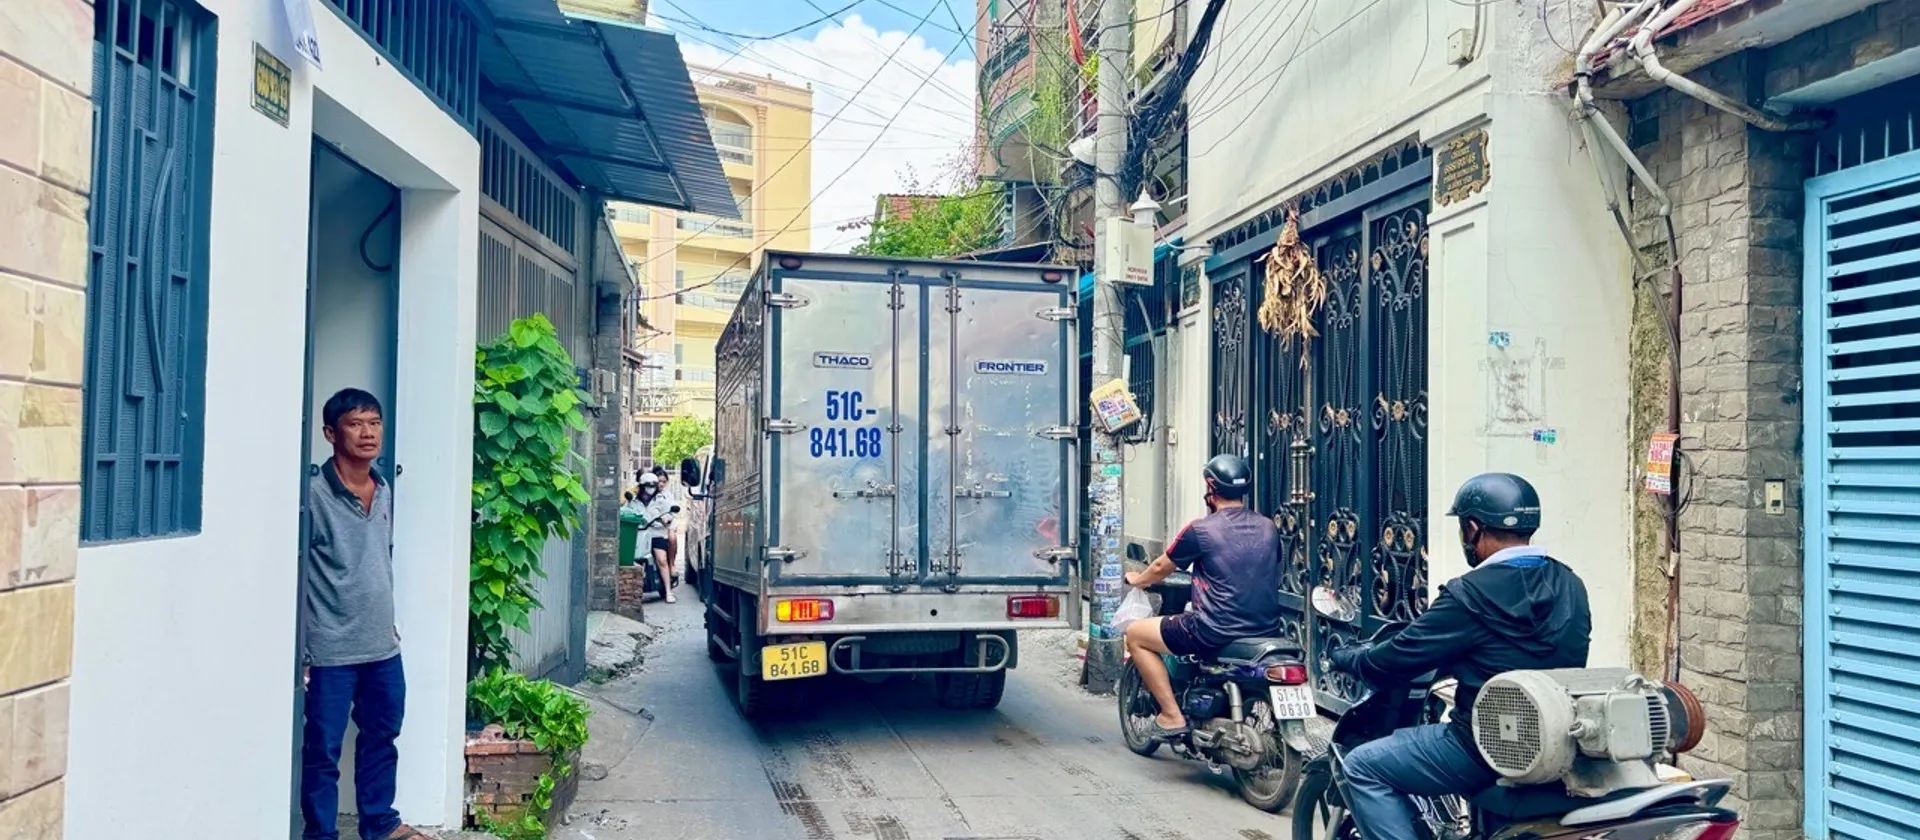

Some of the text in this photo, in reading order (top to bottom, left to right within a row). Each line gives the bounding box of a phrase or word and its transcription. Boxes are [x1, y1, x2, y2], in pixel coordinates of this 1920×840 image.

[819, 355, 870, 366] THACO
[978, 361, 1045, 372] FRONTIER
[826, 390, 877, 421] 51C-
[810, 427, 882, 458] 841.68
[781, 646, 808, 661] 51C
[770, 660, 819, 677] 841.68
[1280, 703, 1311, 717] 0630
